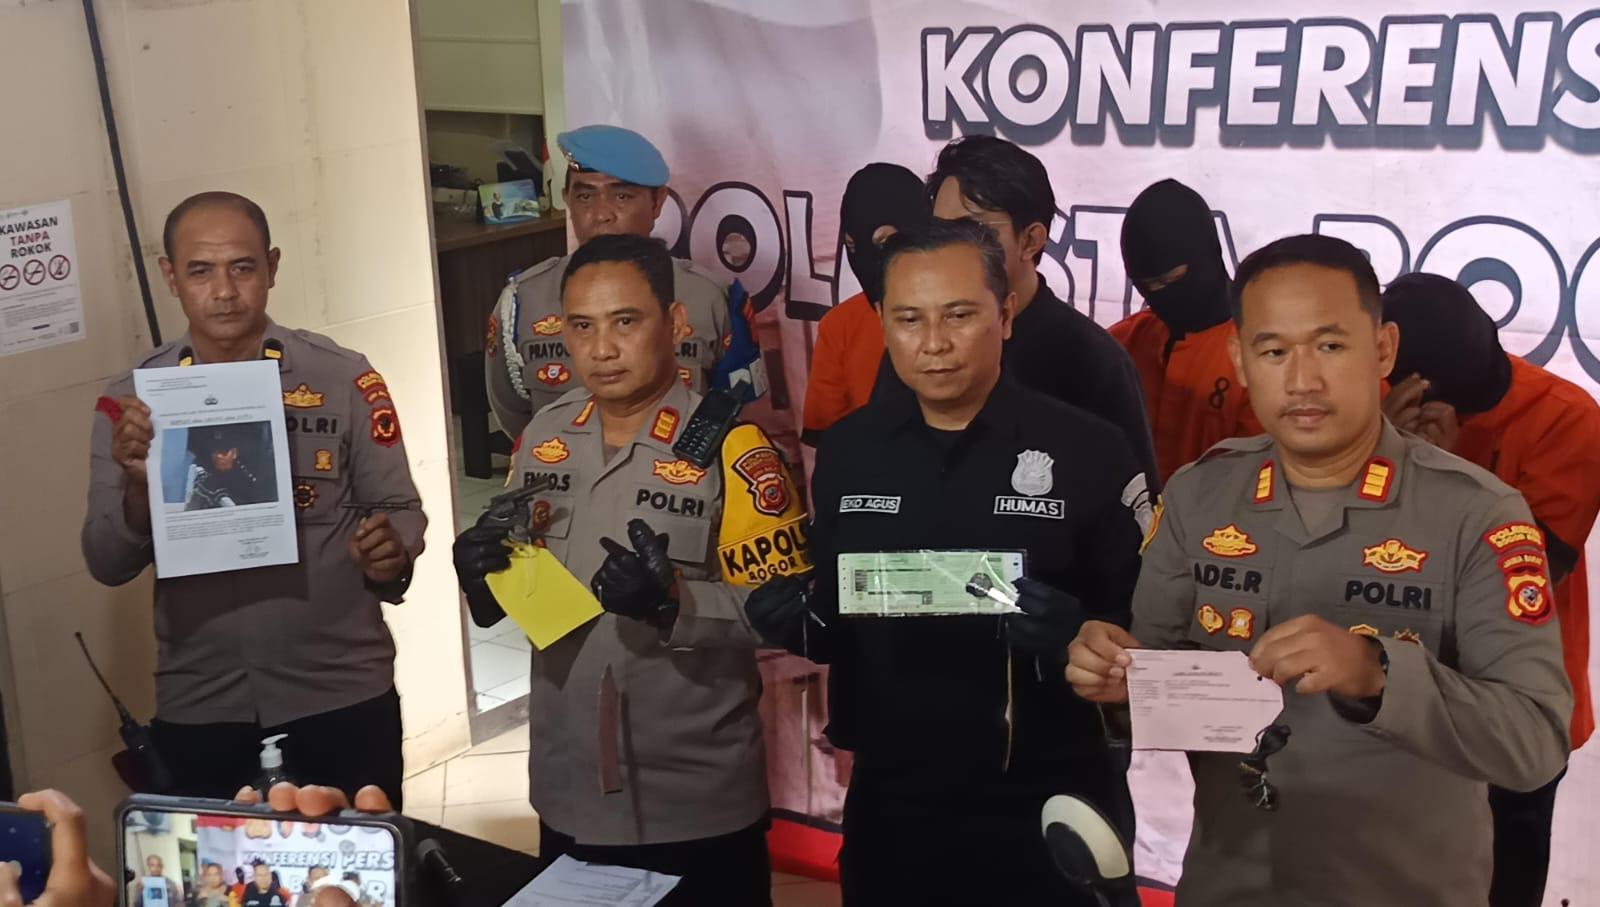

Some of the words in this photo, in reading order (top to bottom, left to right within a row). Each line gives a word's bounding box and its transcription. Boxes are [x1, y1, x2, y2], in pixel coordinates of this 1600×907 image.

[0, 216, 59, 236] KAWASAN
[10, 231, 50, 247] TANPA
[10, 243, 52, 259] ROKOK
[286, 415, 338, 435] OLRI
[636, 488, 704, 517] POLRI
[864, 498, 897, 510] AGUS
[999, 498, 1059, 516] HUMAS
[1344, 580, 1432, 611] POLRI
